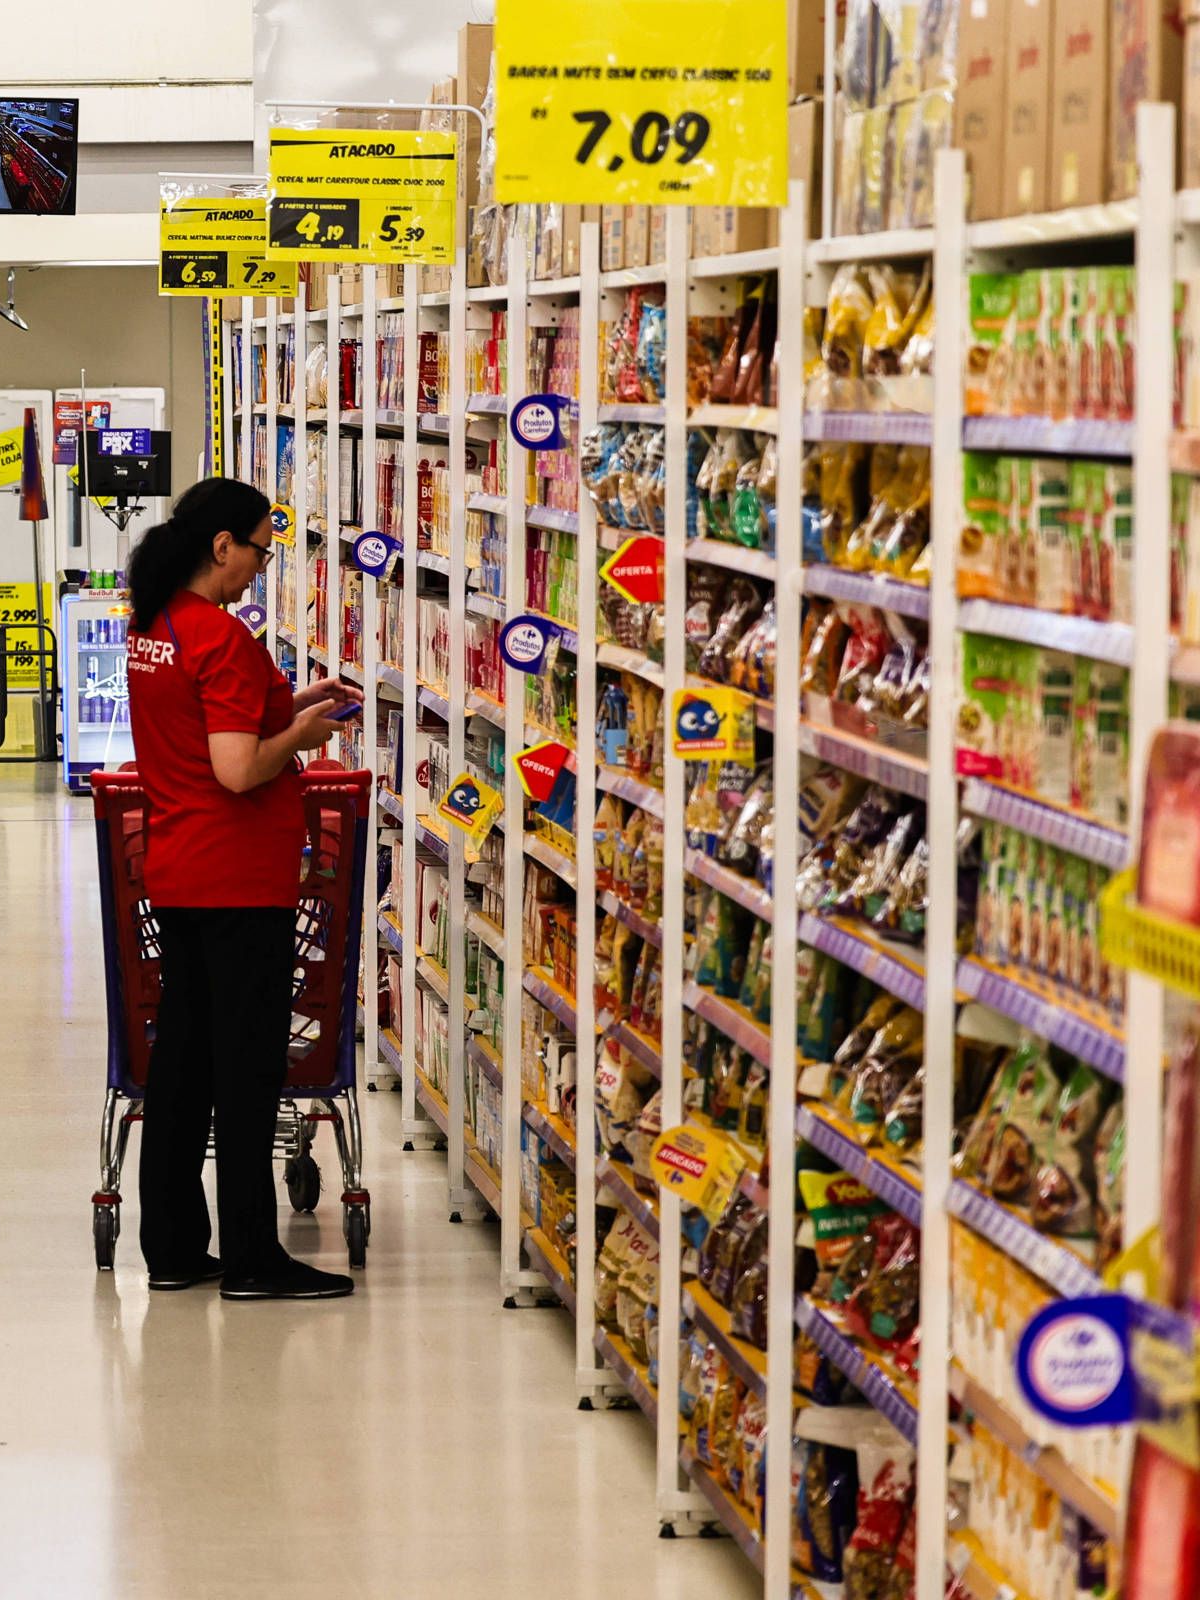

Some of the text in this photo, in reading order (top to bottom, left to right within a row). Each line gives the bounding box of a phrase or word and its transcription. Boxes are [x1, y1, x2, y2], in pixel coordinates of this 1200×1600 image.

[329, 143, 395, 159] ATACADO
[572, 110, 711, 172] 7,09
[276, 176, 304, 184] CEREAL
[325, 177, 370, 185] CARREFOUR
[372, 178, 402, 186] CLASSIC
[403, 178, 423, 186] CHOC
[205, 210, 254, 221] ATACADO
[296, 211, 345, 242] 4,19
[379, 214, 425, 244] 5,39
[181, 261, 217, 284] 6,59
[242, 262, 276, 284] 7,29
[1, 452, 22, 466] LOJA
[613, 565, 654, 577] OFERTA
[88, 589, 114, 597] Red Bull
[521, 758, 556, 779] OFERTA
[659, 1147, 704, 1175] ATACADO
